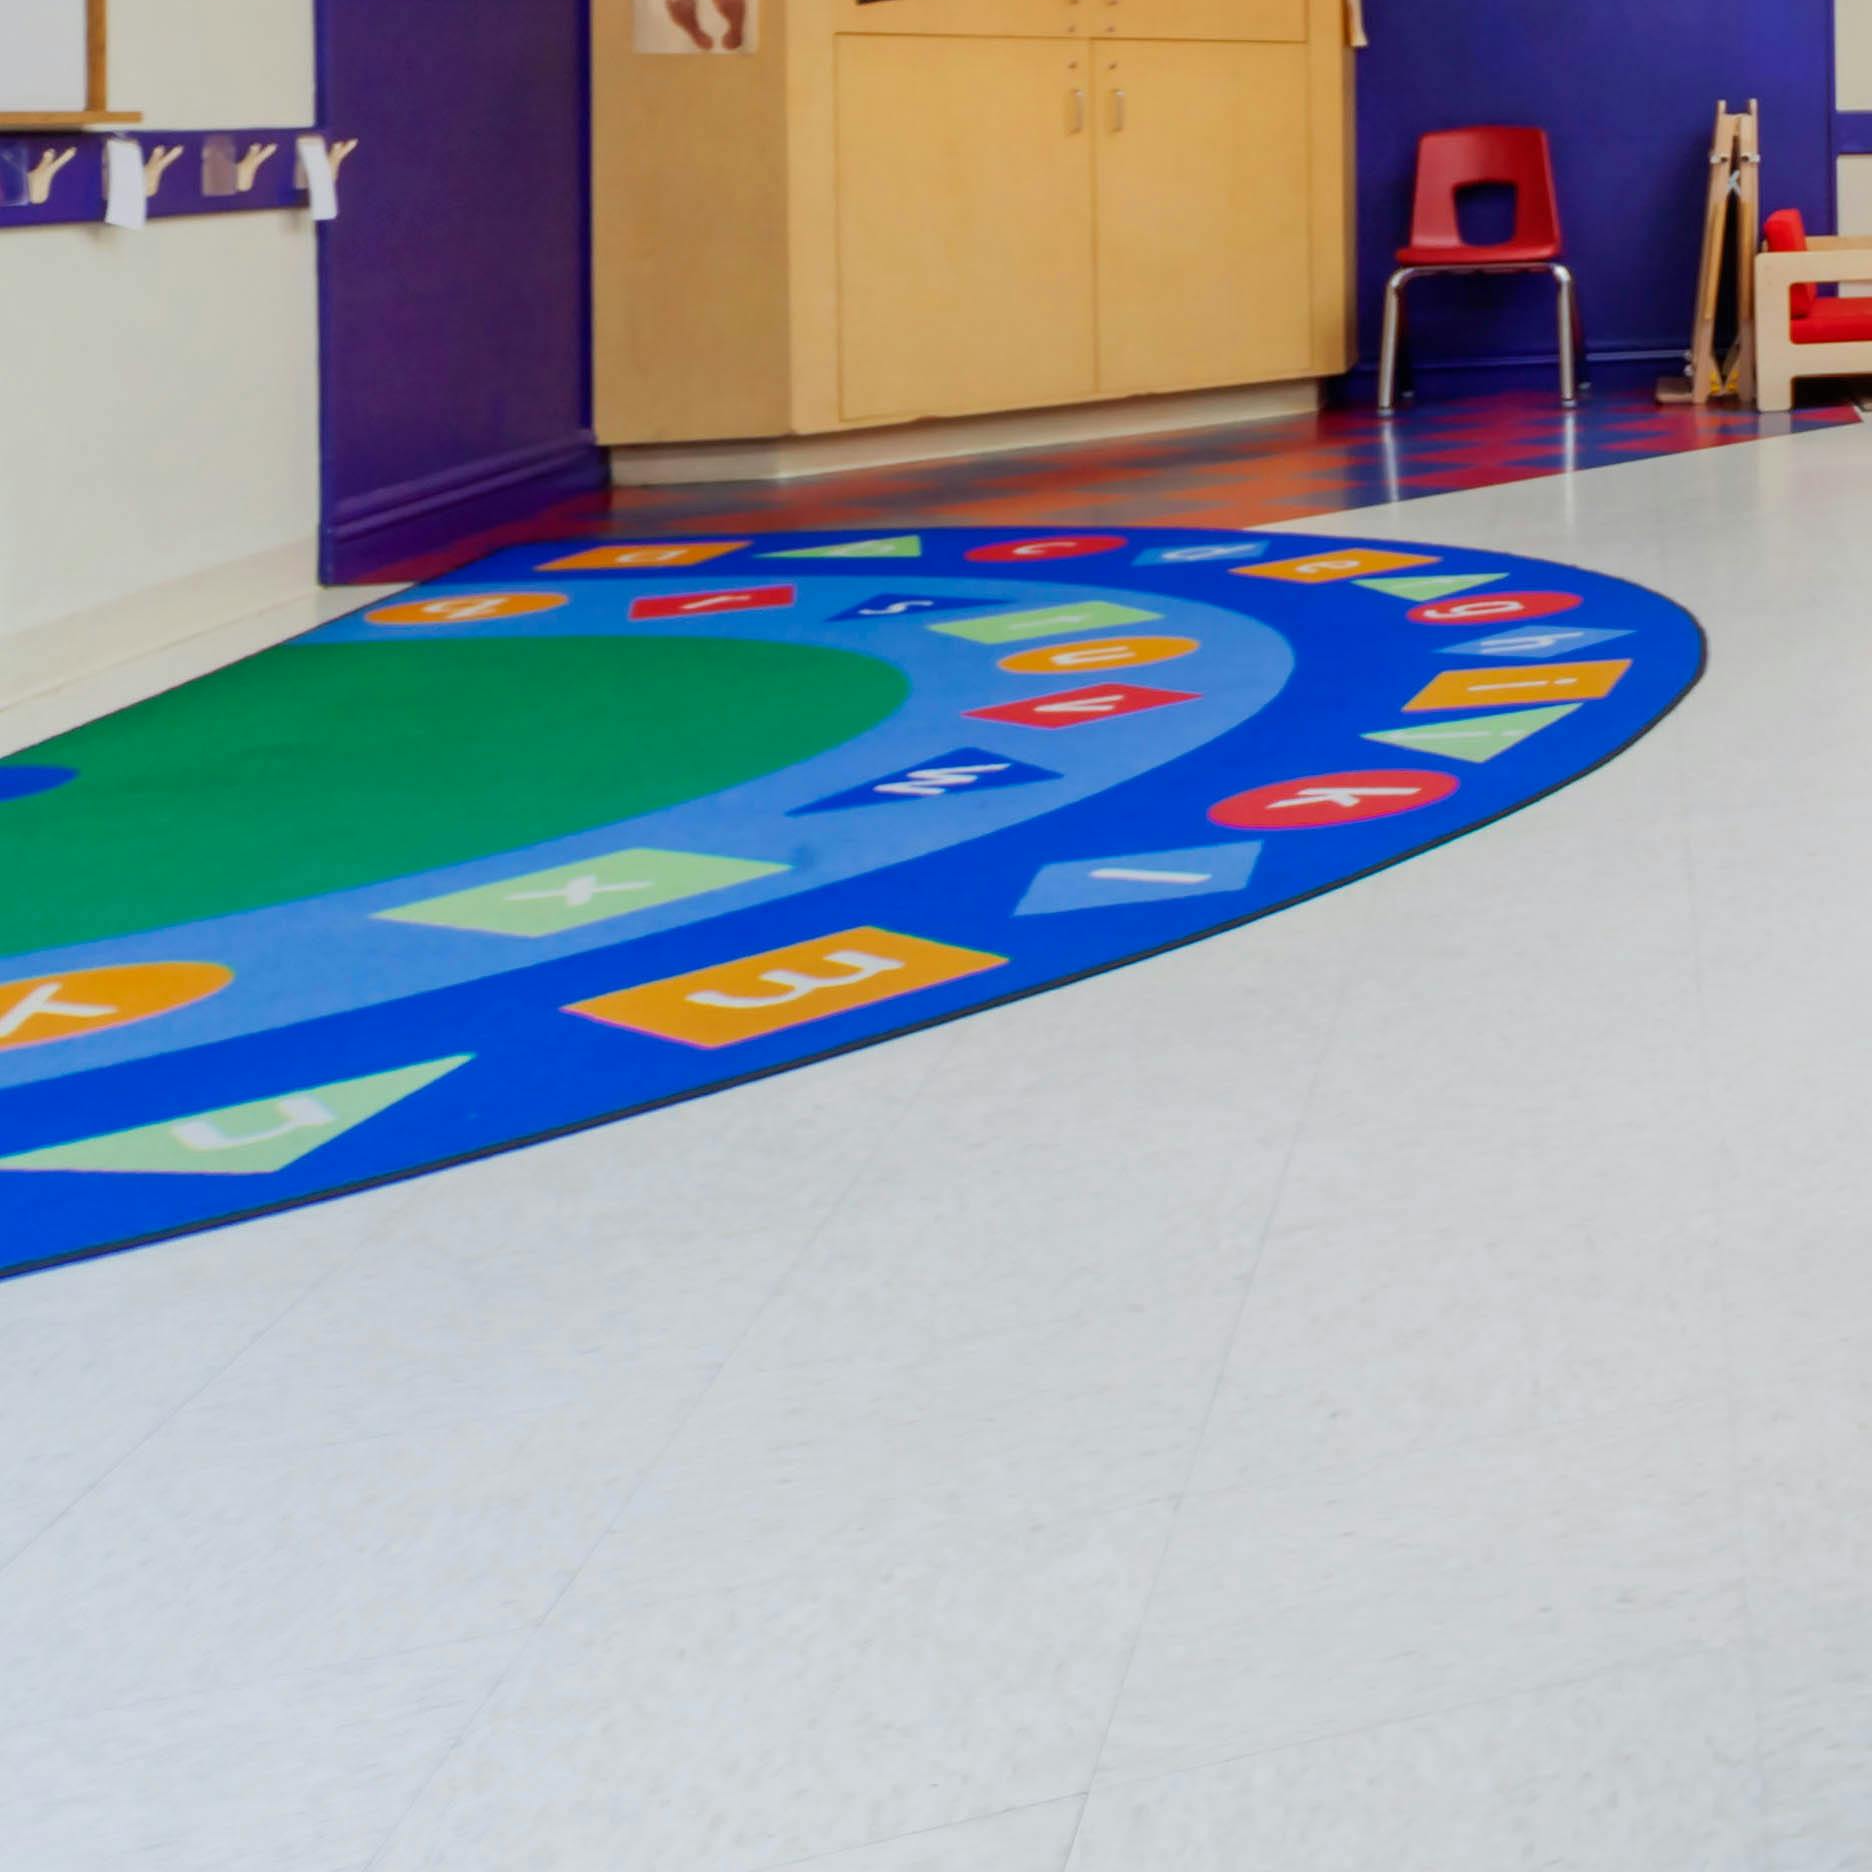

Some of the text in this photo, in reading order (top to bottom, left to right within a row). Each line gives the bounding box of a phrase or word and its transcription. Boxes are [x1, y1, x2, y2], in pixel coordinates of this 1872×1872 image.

[1421, 600, 1526, 619] g
[1480, 632, 1584, 654] h
[1466, 677, 1578, 692] i
[872, 762, 1011, 796] w
[1264, 786, 1422, 809] k
[504, 874, 655, 908] x
[685, 948, 906, 1009] m
